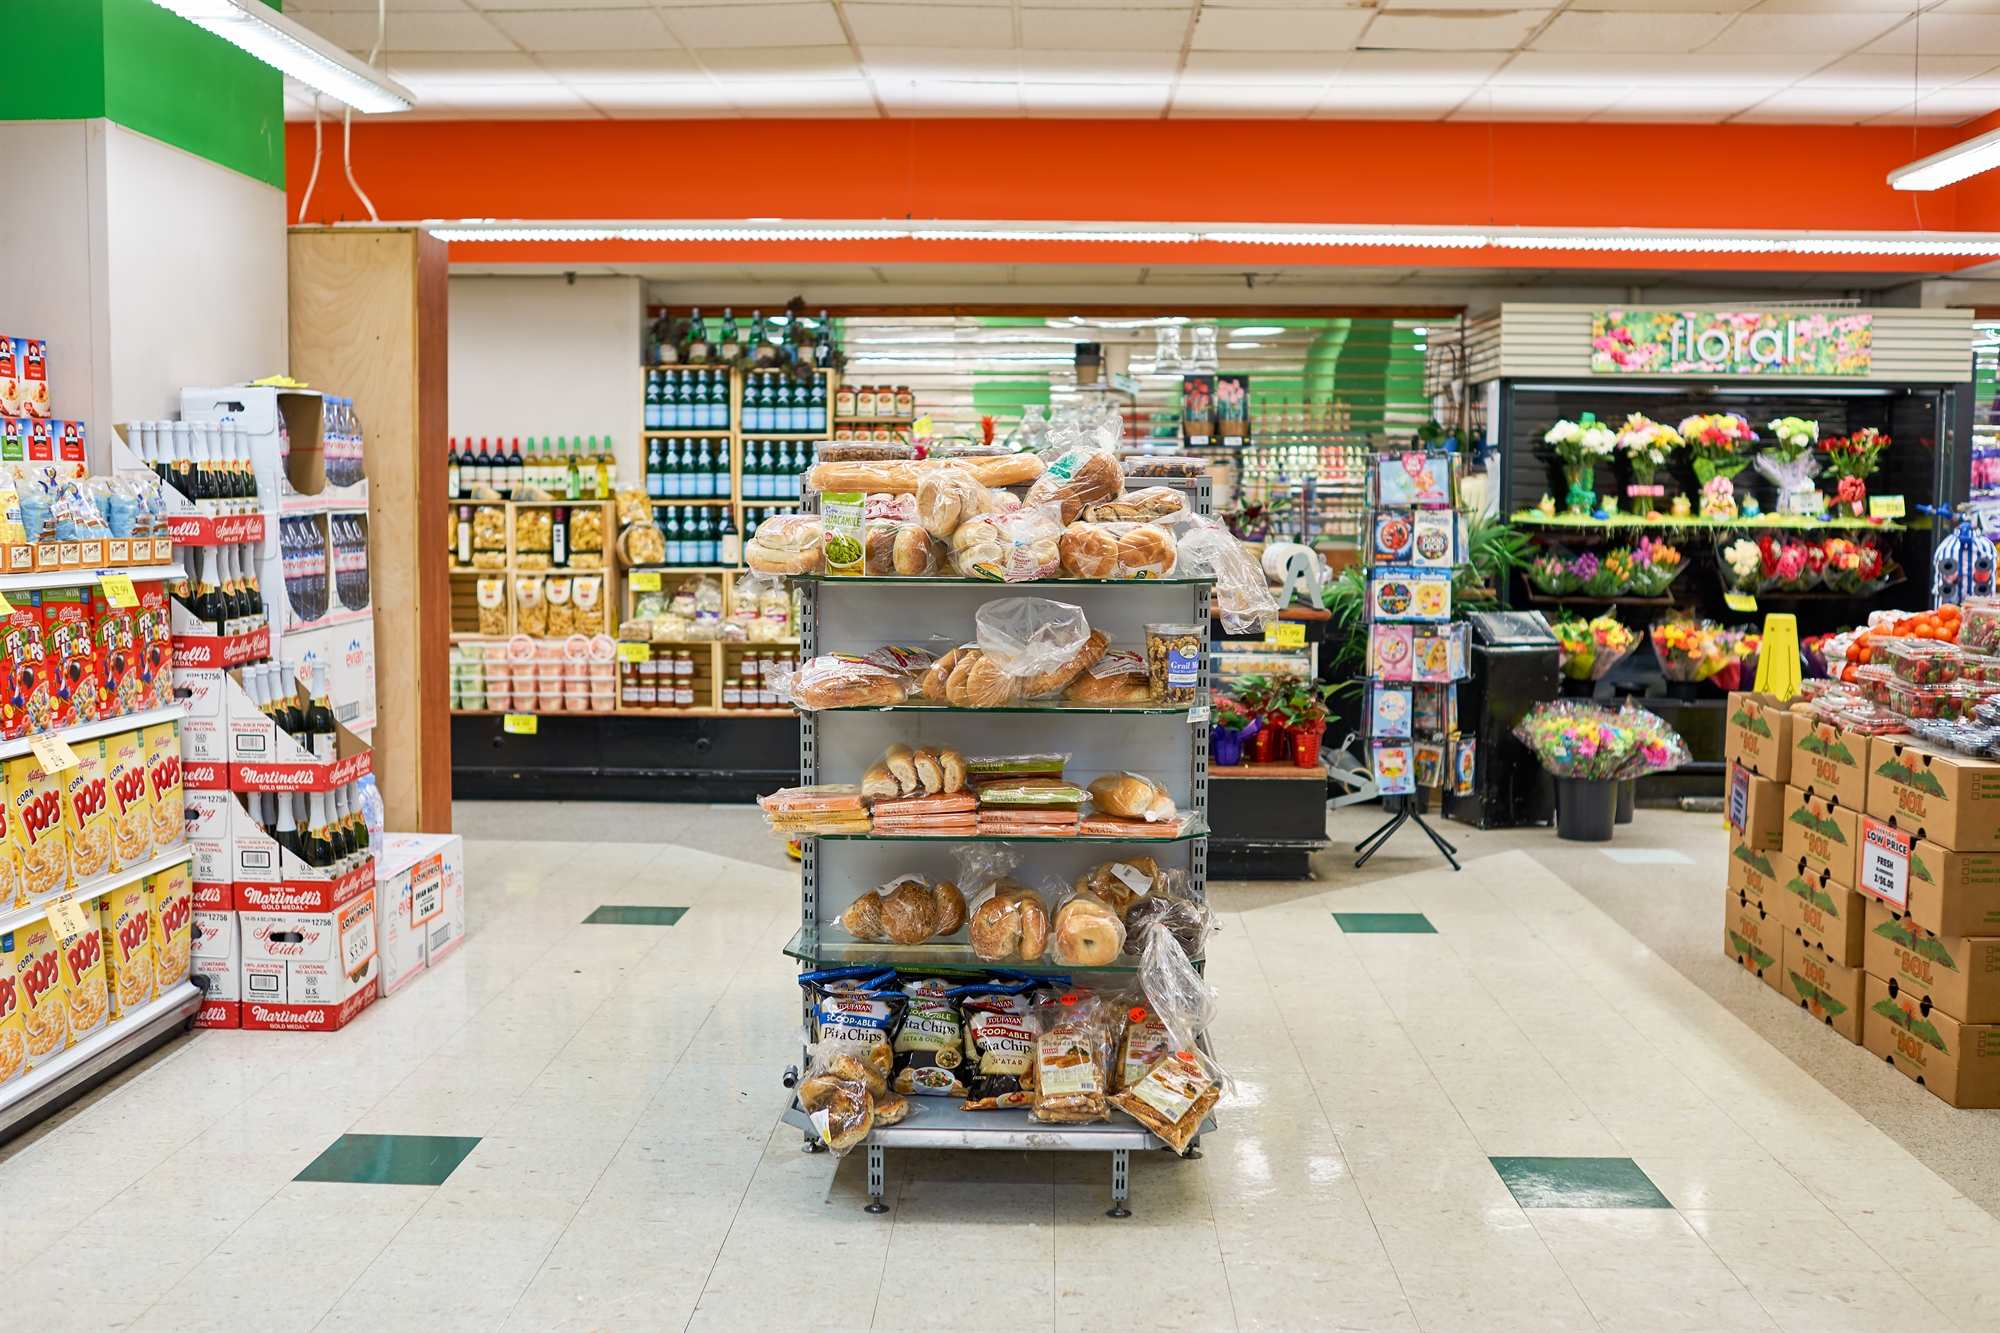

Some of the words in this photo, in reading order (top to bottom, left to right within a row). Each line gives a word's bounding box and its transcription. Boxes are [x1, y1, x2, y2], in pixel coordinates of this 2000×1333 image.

[1669, 318, 1795, 365] floral
[16, 590, 31, 600] WIN
[65, 588, 79, 598] WIN
[111, 585, 129, 595] $2.99
[102, 616, 130, 641] FROOT
[138, 608, 167, 635] FROOT
[5, 625, 39, 653] FROOT
[53, 621, 88, 648] FROOT
[107, 632, 133, 651] LOOPS
[144, 625, 169, 643] LOOPS
[13, 642, 44, 664] LOOPS
[61, 637, 91, 658] LOOPS
[345, 652, 364, 668] evian
[1171, 660, 1190, 670] Grail
[154, 735, 171, 748] Kellogg's
[118, 746, 136, 758] Kellogg's
[147, 752, 160, 769] CORN
[78, 758, 97, 770] Kellogg's
[109, 763, 124, 781] CORN
[1817, 758, 1840, 785] SOL
[68, 774, 84, 793] CORN
[150, 755, 180, 803] POPS
[240, 766, 314, 784] Martinelli's
[16, 787, 34, 807] CORN
[113, 766, 146, 816] POPS
[70, 777, 107, 831] POPS
[1899, 788, 1927, 818] SOL
[19, 790, 61, 846] POPS
[1809, 833, 1831, 861] SOL
[1866, 828, 1884, 845] LOW
[1885, 838, 1908, 856] PRICE
[1876, 856, 1894, 870] FRESH
[413, 870, 427, 884] LOW
[427, 864, 441, 878] PRICE
[1747, 868, 1764, 894] SOL
[123, 892, 141, 907] Kellogg's
[244, 887, 322, 906] Martinelli's
[415, 888, 427, 901] EVIAN
[427, 881, 440, 895] WATER
[158, 895, 173, 913] CORN
[261, 903, 281, 911] GOLD
[115, 911, 129, 930] CORN
[160, 894, 191, 945] POPS
[311, 918, 332, 926] 12756
[341, 916, 356, 930] LOW
[356, 901, 372, 922] PRICE
[1803, 903, 1825, 933] SOL
[26, 930, 48, 947] Kellogg's
[117, 910, 148, 964] POPS
[65, 929, 100, 987] POPS
[264, 941, 304, 956] Cider
[16, 951, 34, 973] CORN
[1902, 951, 1934, 986] SOL
[19, 949, 59, 1010] POPS
[1803, 956, 1826, 988] SOL
[305, 988, 319, 996] U.S.
[251, 1005, 325, 1024] Martinelli's
[838, 1002, 872, 1012] TOUFAYAN
[1131, 1010, 1145, 1021] $2.49
[921, 1020, 956, 1035] Chips
[987, 1017, 1023, 1025] TOUFAYAN
[824, 1027, 847, 1040] Pita
[847, 1028, 882, 1043] Chips
[924, 1036, 945, 1045] OLIVE
[1000, 1039, 1034, 1054] Chips
[1897, 1030, 1927, 1067] SOL
